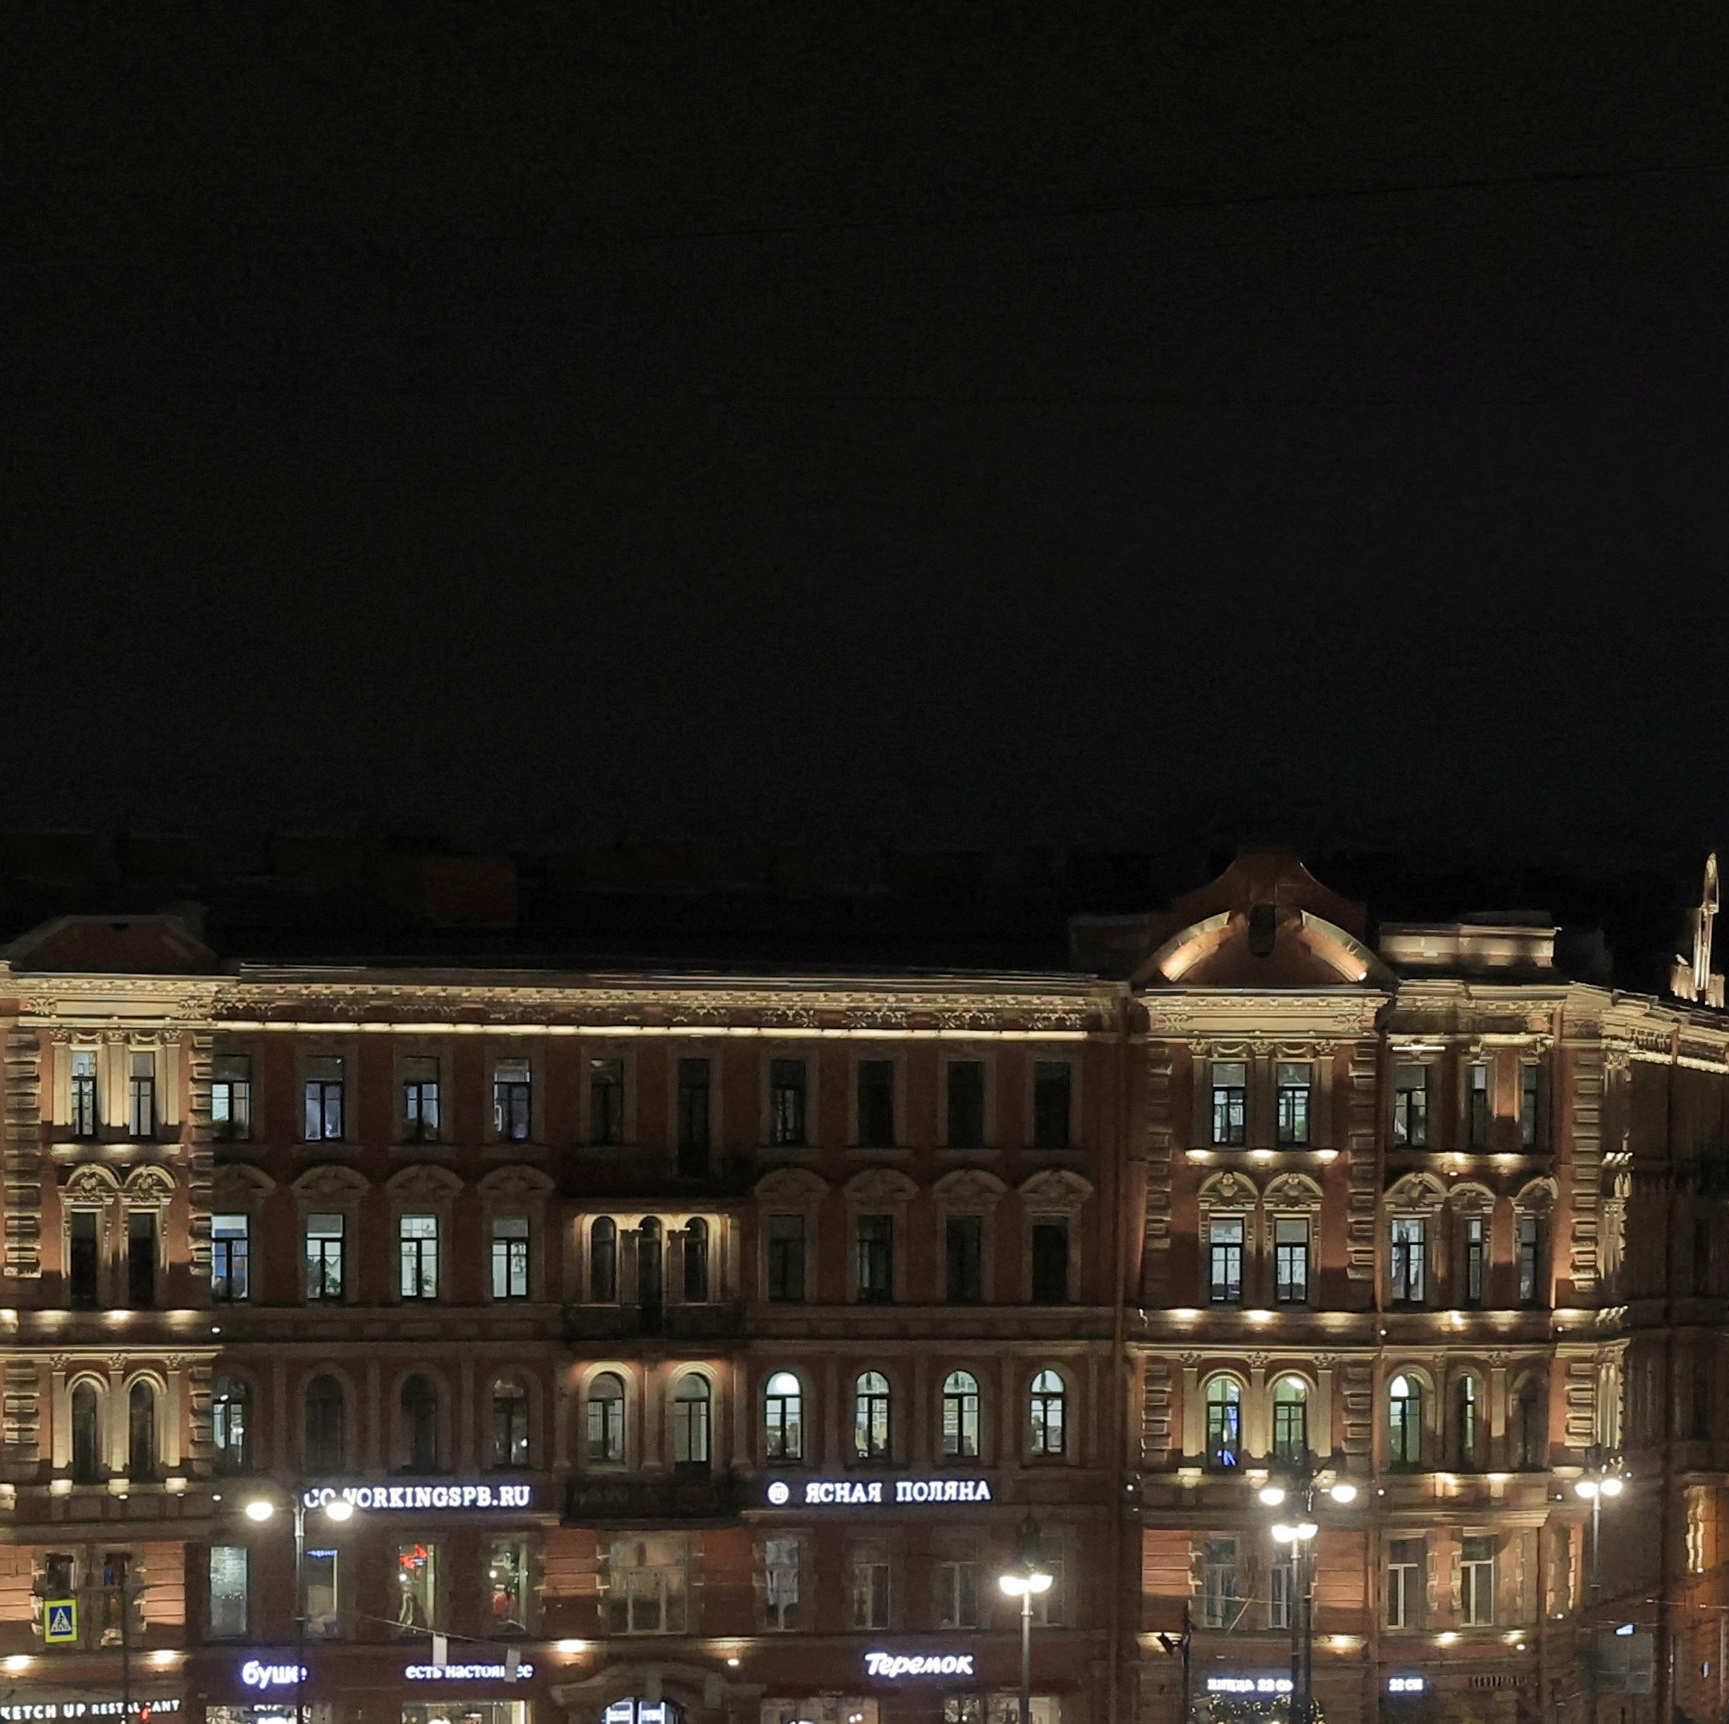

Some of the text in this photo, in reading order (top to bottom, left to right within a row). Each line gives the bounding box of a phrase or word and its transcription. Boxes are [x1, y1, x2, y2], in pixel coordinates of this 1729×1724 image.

[805, 1480, 991, 1503] ЯСНАЯ ПОЛЯНА
[405, 1665, 441, 1679] есть
[865, 1652, 974, 1678] Теремок
[0, 1704, 57, 1720] KETCH
[63, 1703, 86, 1718] UP
